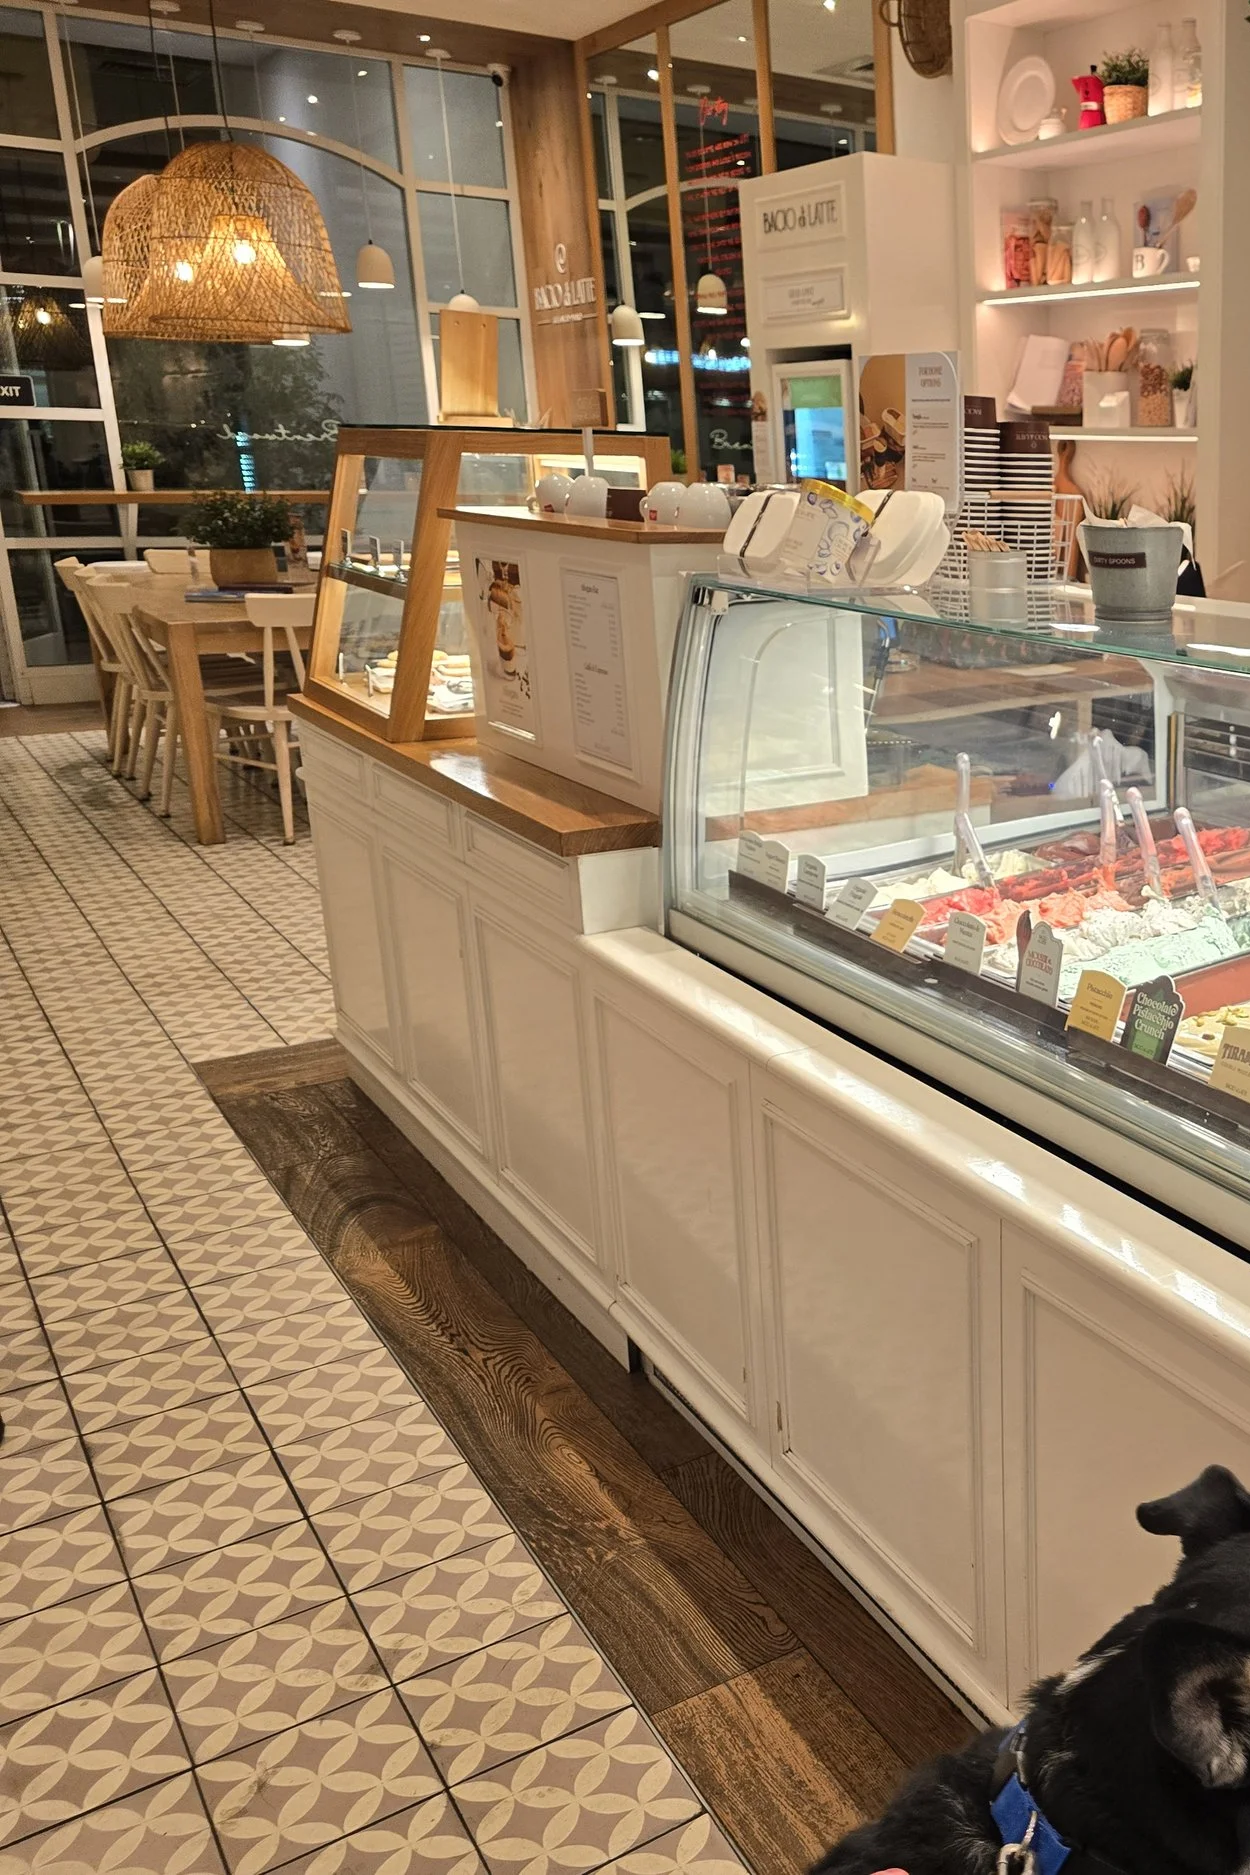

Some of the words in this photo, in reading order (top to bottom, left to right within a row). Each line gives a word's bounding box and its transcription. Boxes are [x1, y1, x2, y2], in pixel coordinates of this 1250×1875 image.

[0, 386, 21, 397] XIT
[1109, 557, 1136, 565] SPOONS
[1137, 991, 1179, 1016] Chocolate
[1132, 1003, 1174, 1030] Pistacchio
[1134, 1018, 1165, 1040] Crunch
